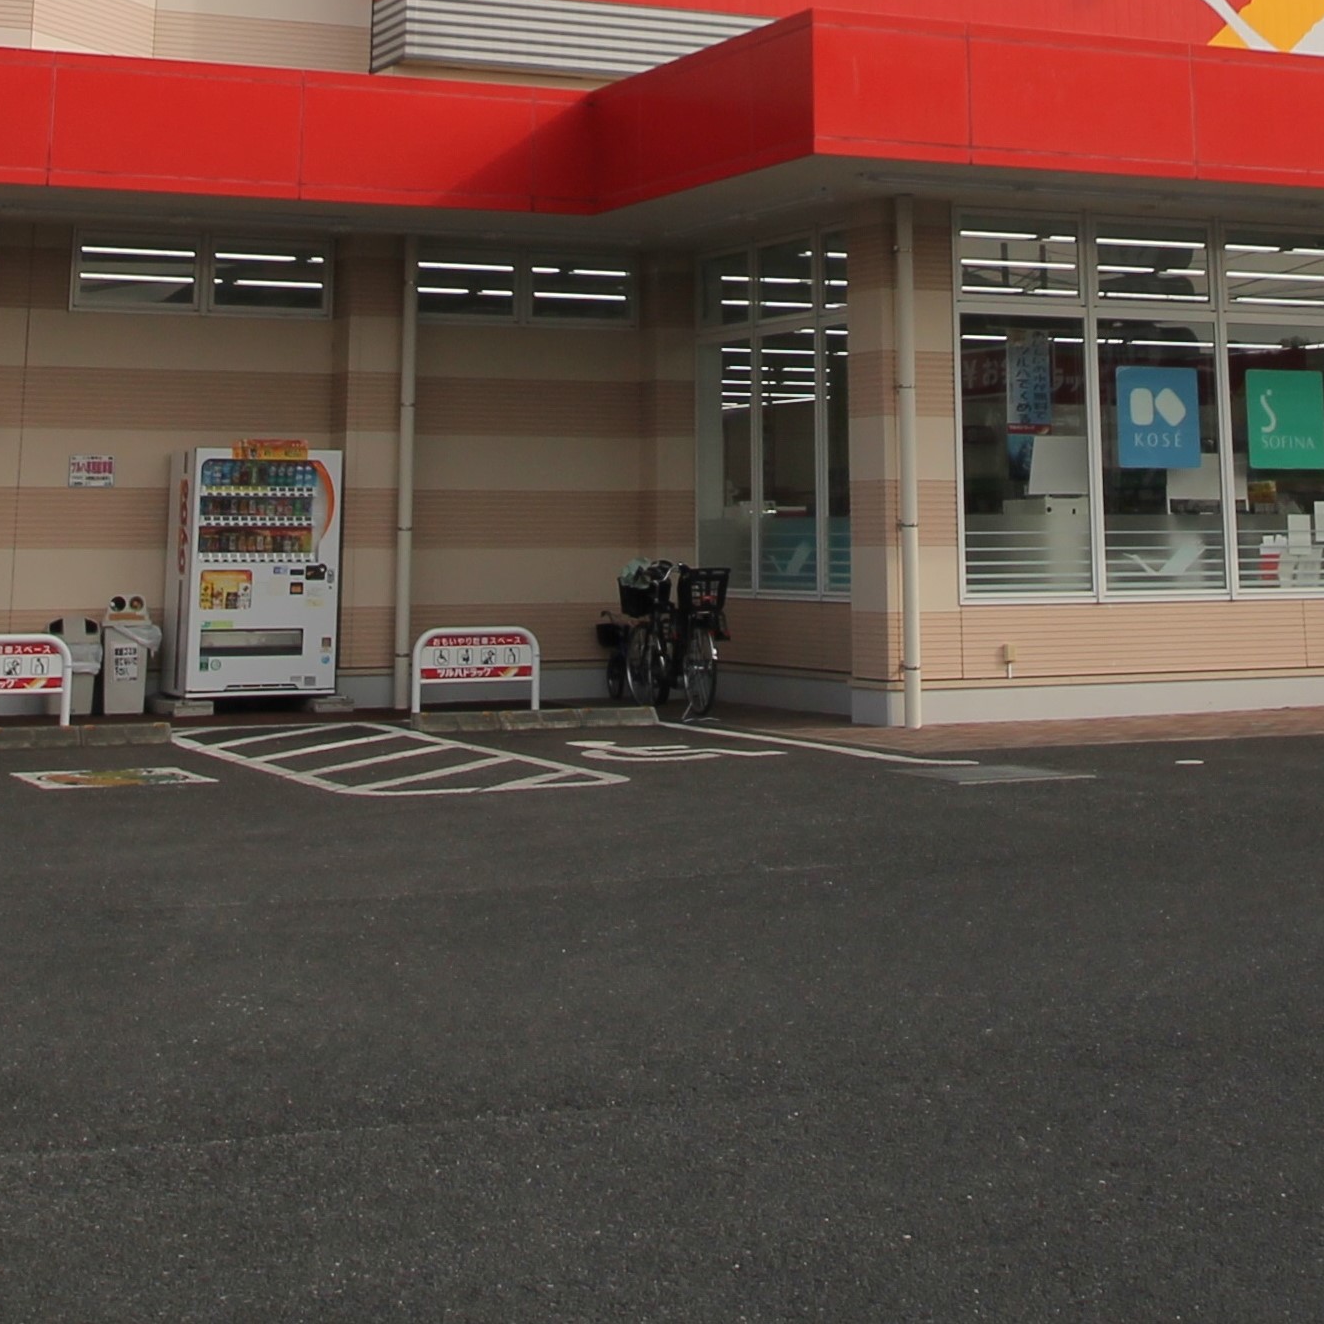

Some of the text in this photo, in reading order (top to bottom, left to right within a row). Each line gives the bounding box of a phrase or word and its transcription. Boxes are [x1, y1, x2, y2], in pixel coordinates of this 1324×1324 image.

[1134, 431, 1183, 448] KOSÉ
[1261, 435, 1316, 449] SOFINA
[437, 667, 494, 678] ツルハドラッグ
